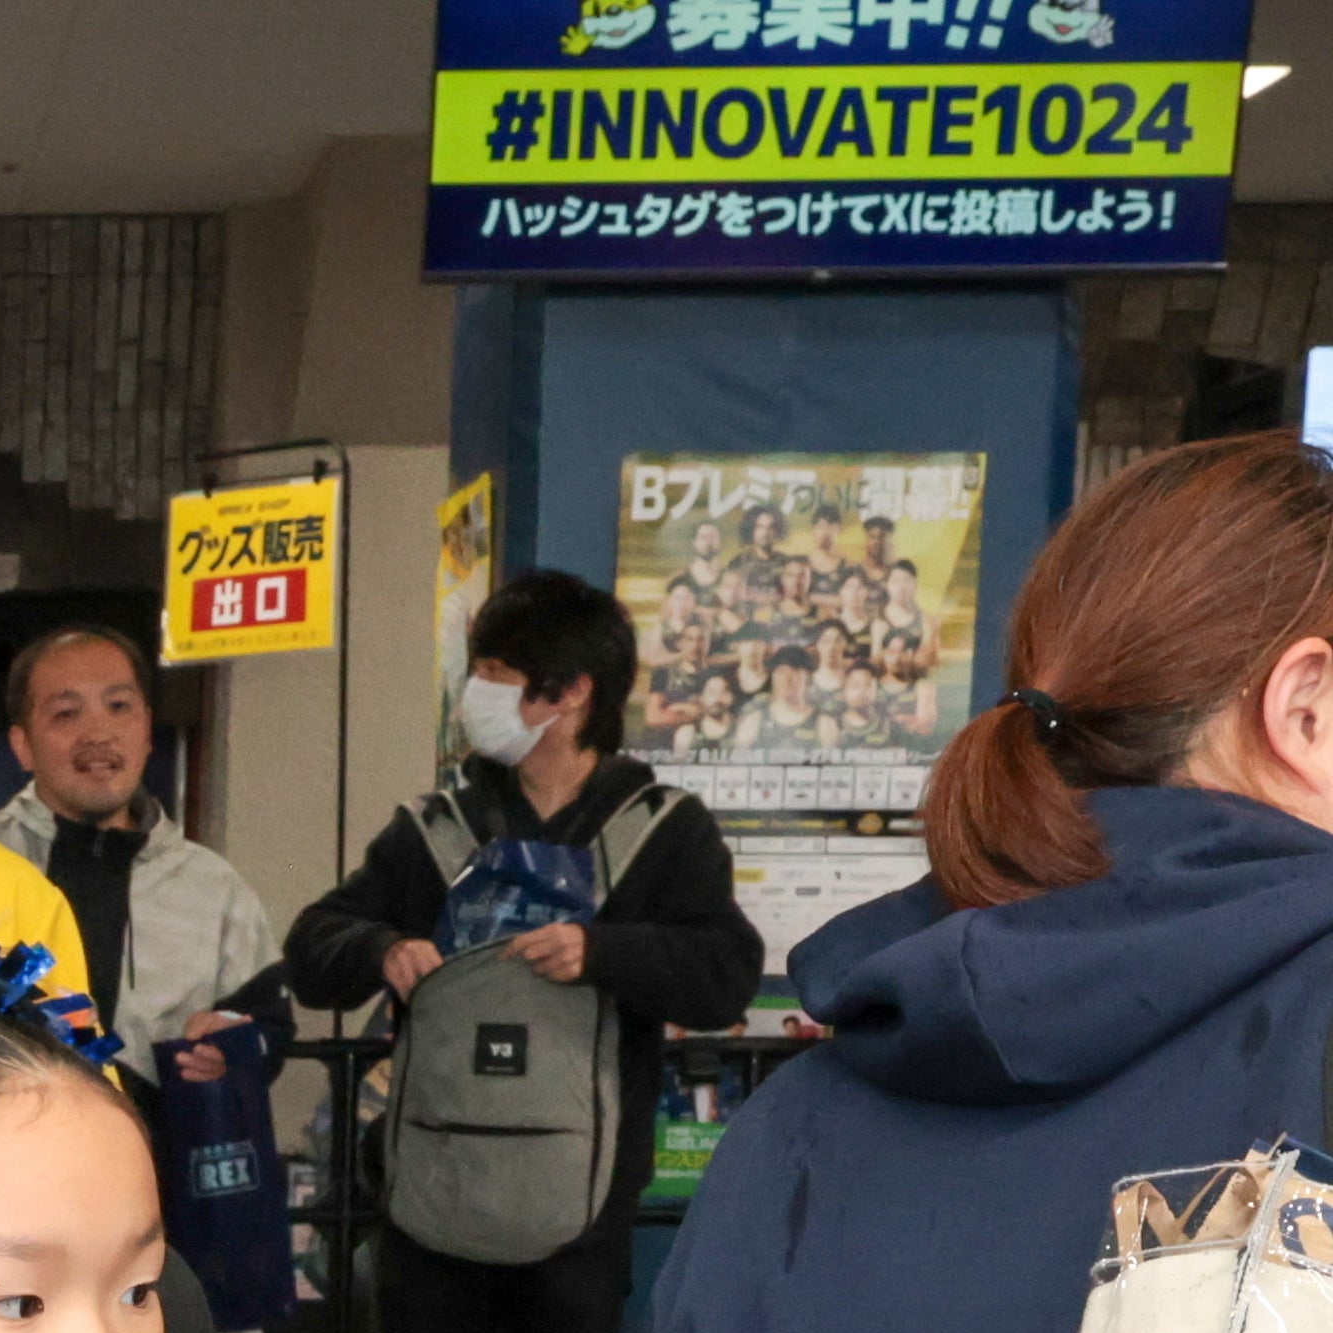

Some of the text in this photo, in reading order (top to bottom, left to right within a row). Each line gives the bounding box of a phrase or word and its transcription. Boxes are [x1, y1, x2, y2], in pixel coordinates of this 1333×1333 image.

[487, 83, 1193, 161] #INNOVATE1024
[481, 190, 1175, 237] ハッシュタグをつけてXに投稿しよう!
[178, 514, 326, 575] グッズ販売
[210, 575, 288, 628] 出口
